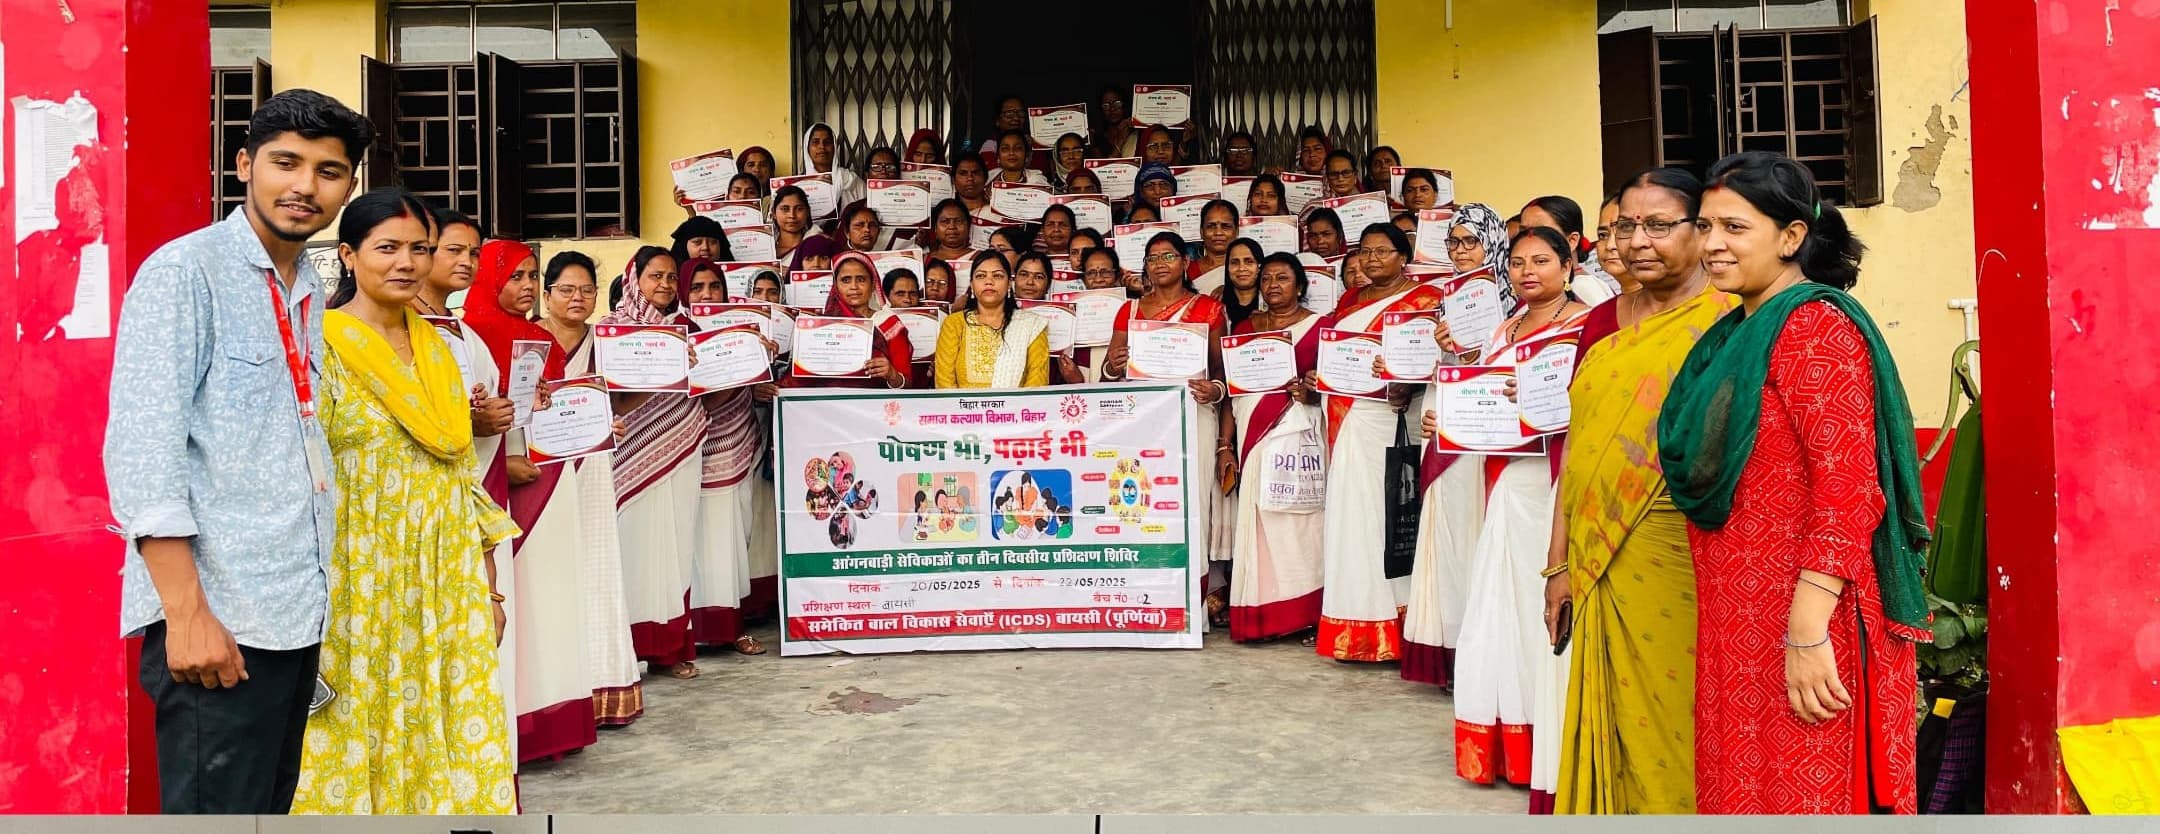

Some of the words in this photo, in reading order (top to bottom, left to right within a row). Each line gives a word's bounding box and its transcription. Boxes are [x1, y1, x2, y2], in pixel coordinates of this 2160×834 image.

[960, 399, 978, 410] बिहार
[981, 400, 1005, 409] सरकार
[919, 415, 947, 426] समाज
[951, 413, 982, 425] कल्याण
[986, 410, 1018, 424] विभाग,
[1021, 409, 1047, 422] बिहार
[878, 435, 947, 463] पोषण
[993, 430, 1053, 465] पढ़ाई
[1060, 430, 1088, 457] भी
[832, 553, 893, 571] आंगनवाड़ी
[897, 551, 953, 568] सेविकाओं
[957, 553, 973, 565] का
[976, 550, 999, 565] तीन
[1003, 549, 1049, 564] दिवसीय
[1052, 548, 1100, 563] प्रशिक्षण
[1104, 547, 1139, 562] शिविर
[911, 580, 981, 592] 20/05/2025
[1059, 577, 1126, 588] 22/05/2025
[802, 600, 843, 613] प्रशिक्षण
[808, 617, 864, 633] समेकित
[868, 617, 899, 631] बाल
[903, 614, 951, 629] विकास
[999, 613, 1051, 629] (ICDS)
[1056, 609, 1101, 625] बायसी
[1105, 609, 1167, 627] (पूर्णिया)
